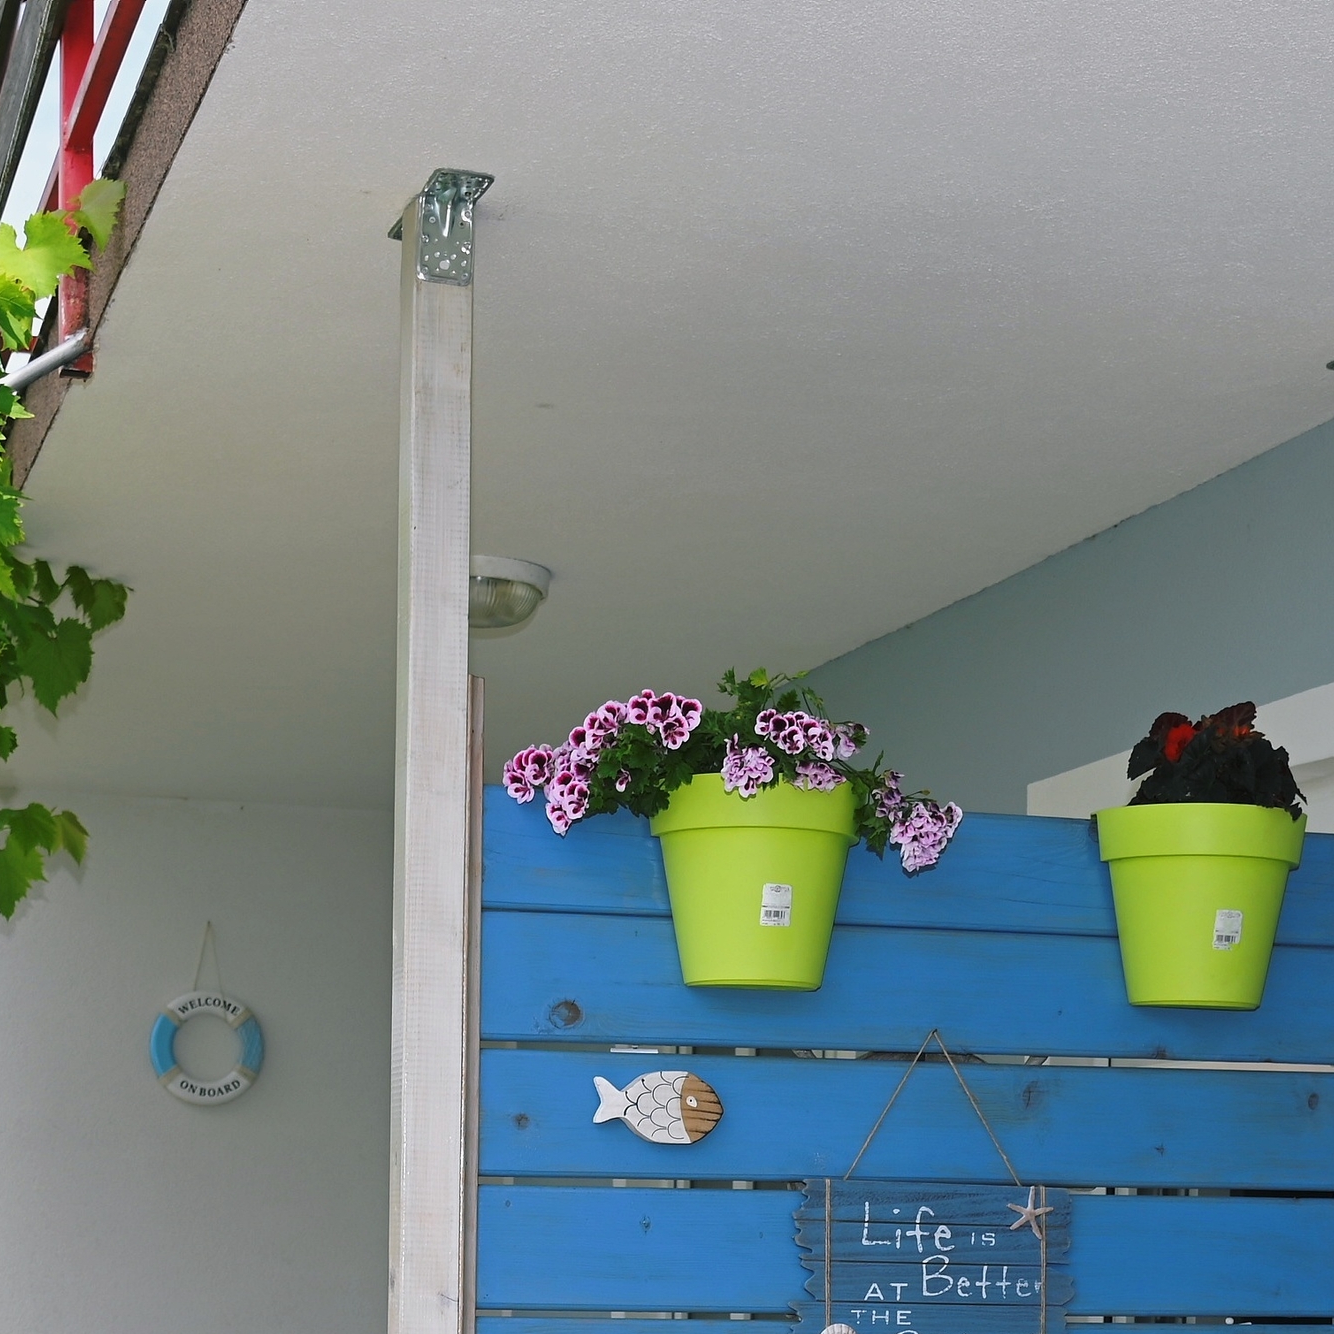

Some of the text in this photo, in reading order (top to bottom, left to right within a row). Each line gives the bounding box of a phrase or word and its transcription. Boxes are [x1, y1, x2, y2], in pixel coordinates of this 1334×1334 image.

[178, 997, 240, 1016] WELCOME
[862, 1201, 955, 1253] Life
[863, 1282, 909, 1301] AT
[850, 1309, 912, 1326] THE
